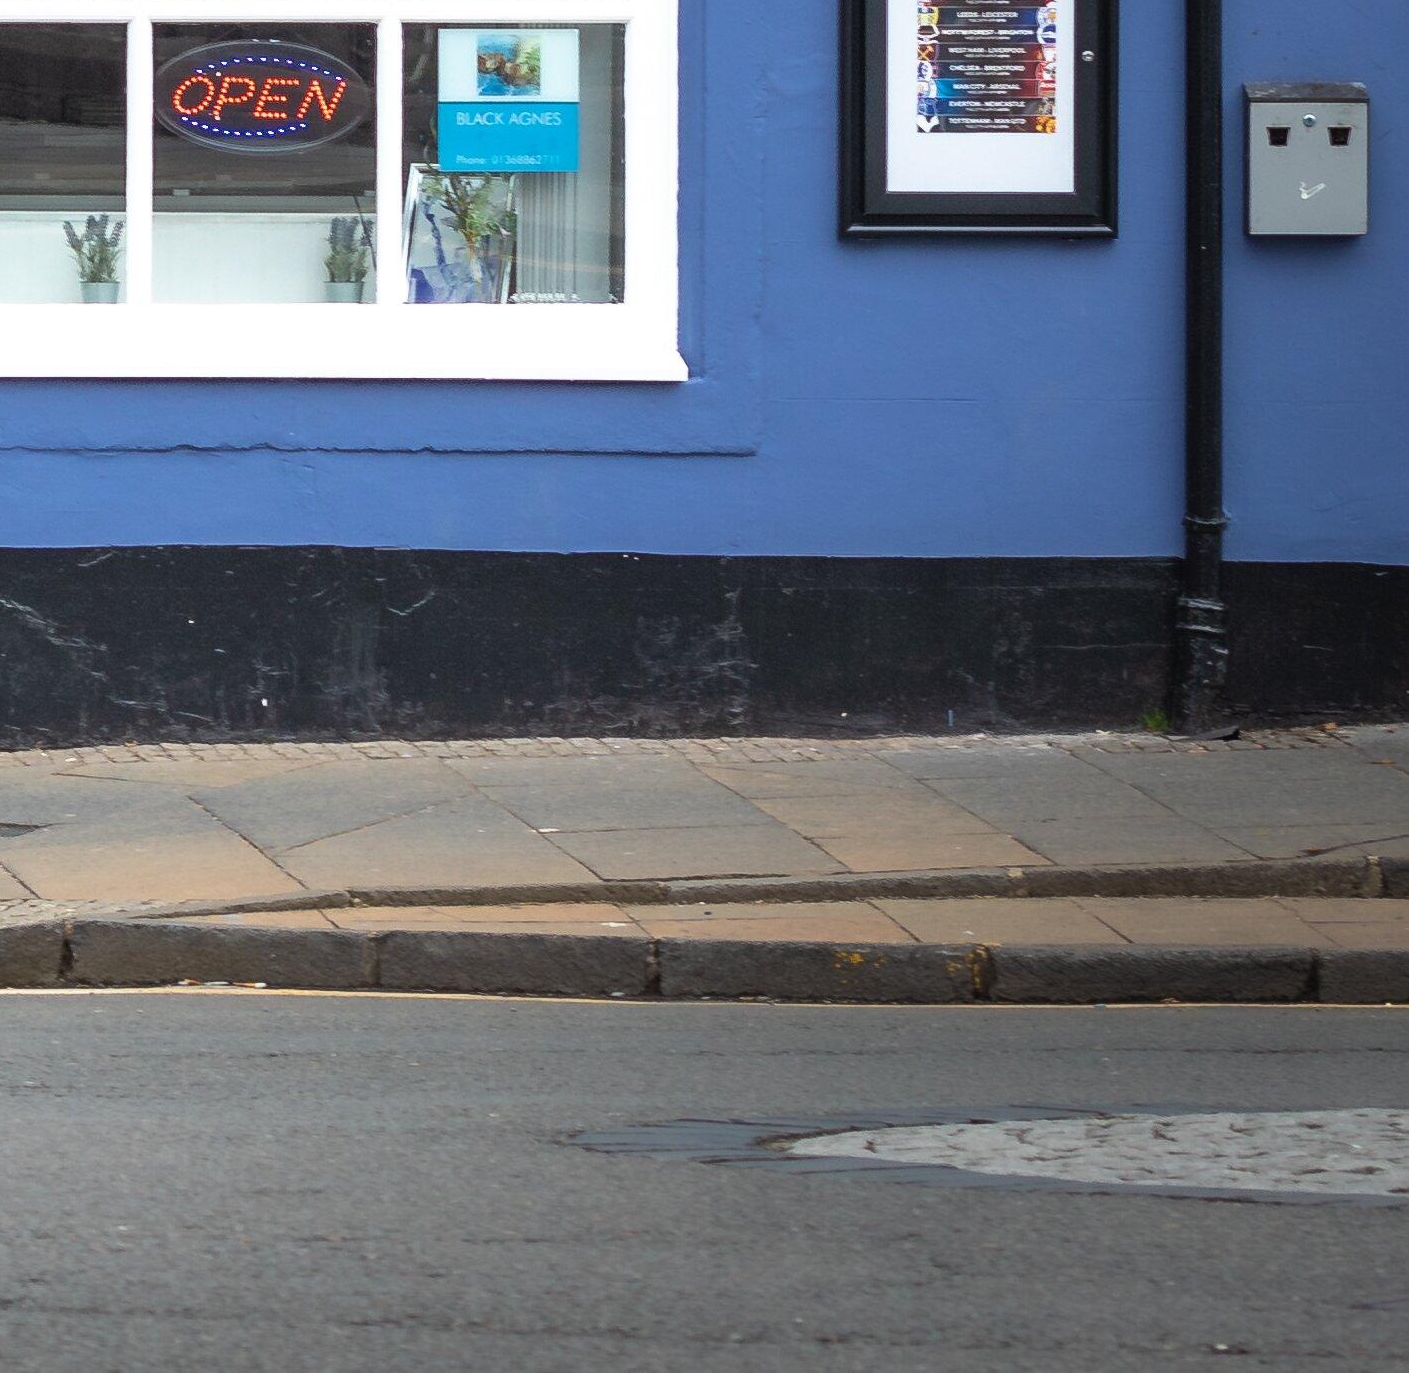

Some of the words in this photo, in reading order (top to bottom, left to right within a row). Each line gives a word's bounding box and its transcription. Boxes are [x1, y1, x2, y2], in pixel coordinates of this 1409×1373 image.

[171, 74, 349, 123] OPEN
[456, 111, 504, 126] BLACK
[508, 111, 562, 126] AGNES
